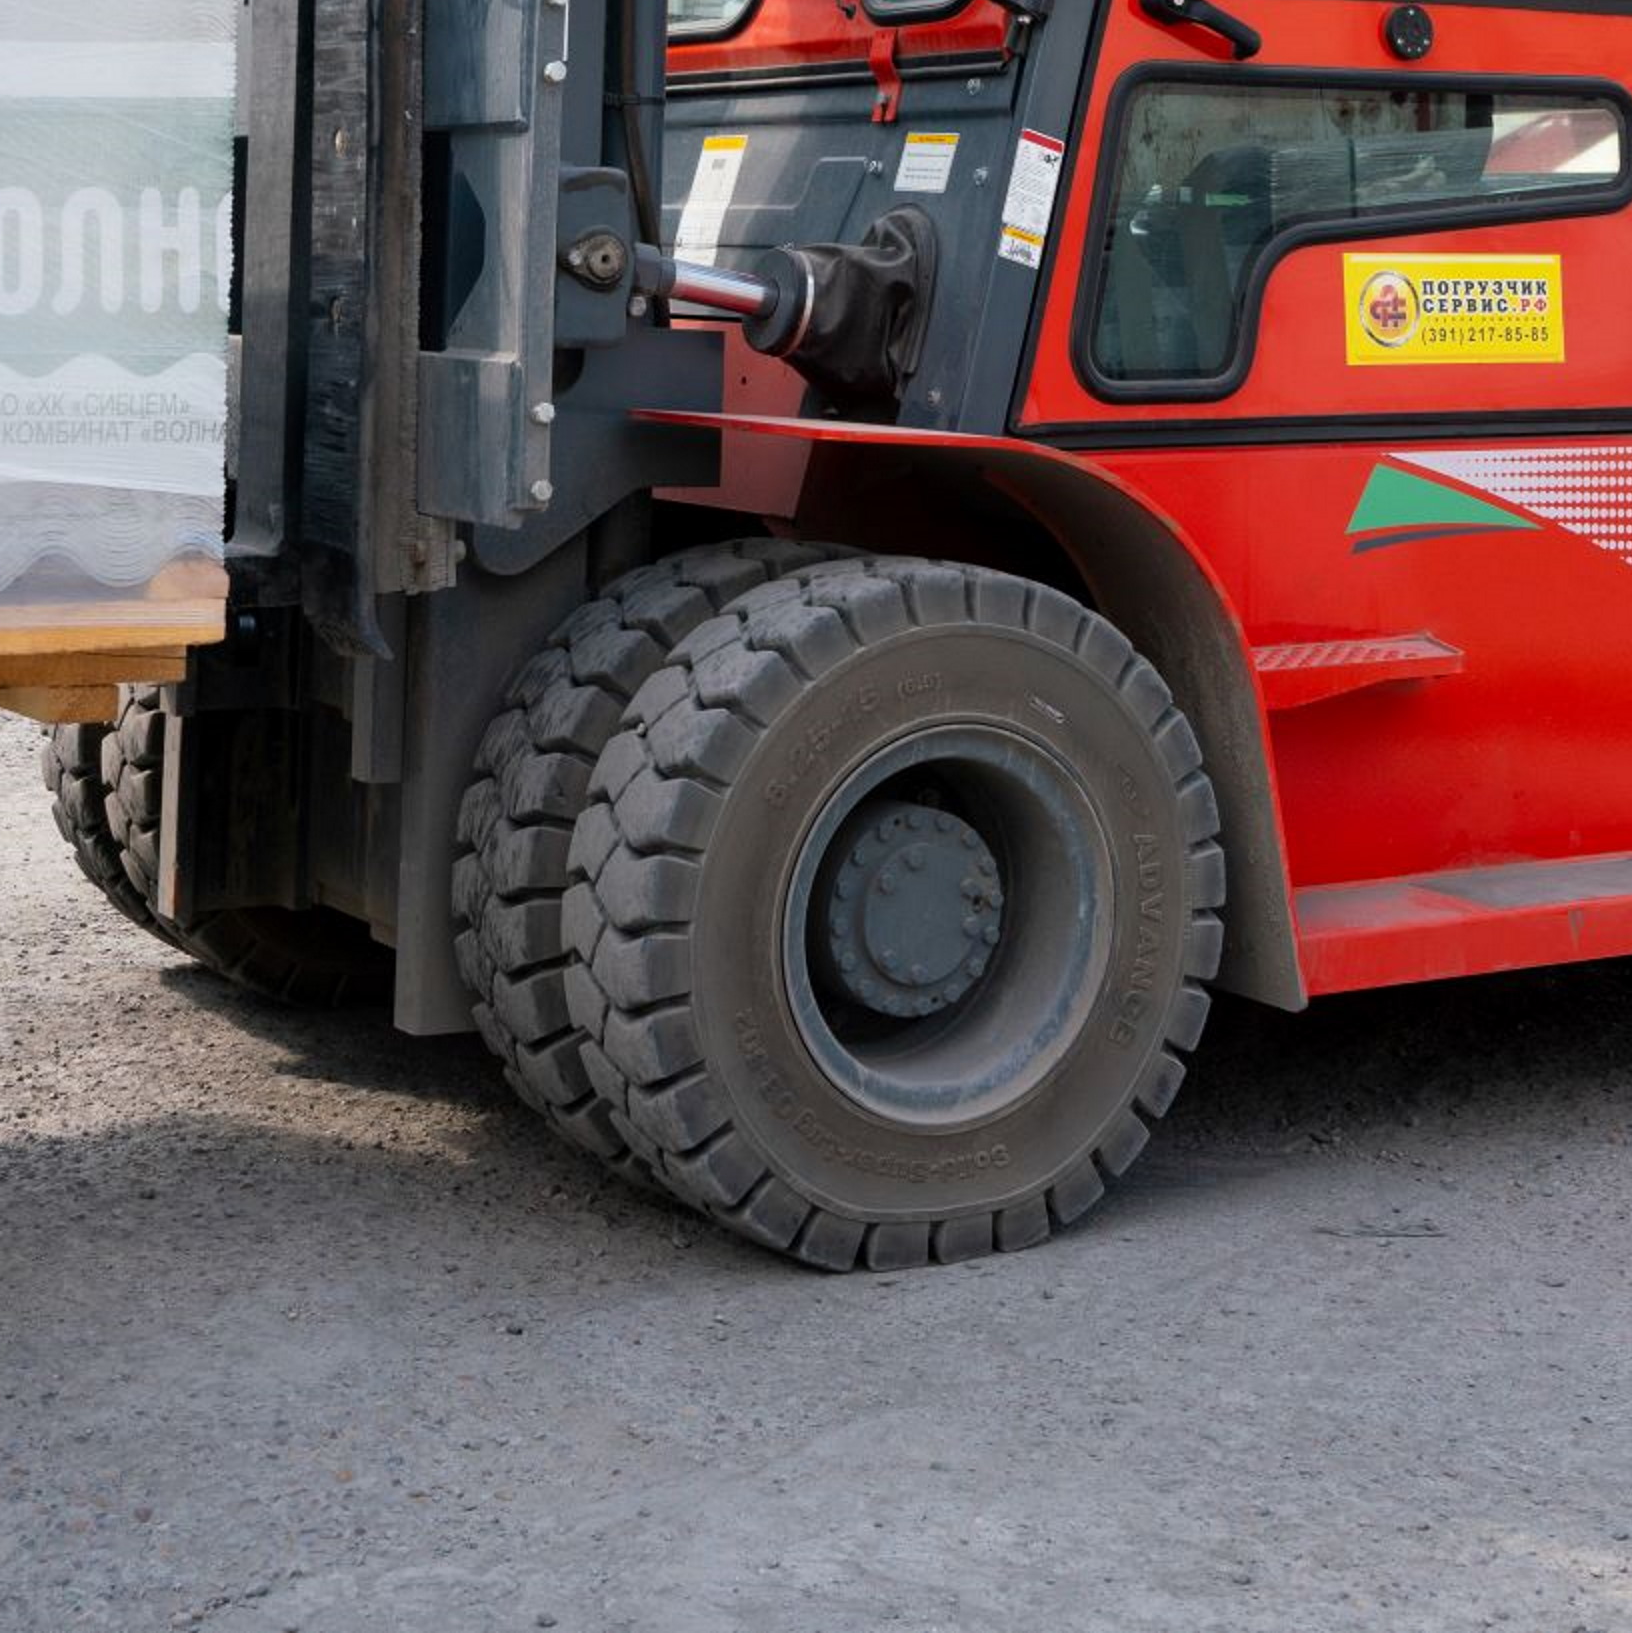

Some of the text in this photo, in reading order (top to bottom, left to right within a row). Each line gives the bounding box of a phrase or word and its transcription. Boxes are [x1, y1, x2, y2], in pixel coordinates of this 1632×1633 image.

[1421, 279, 1548, 296] ПОГРУЗЧИК
[1421, 298, 1548, 314] СЕРВИС.РФ
[26, 392, 64, 417] «ХК
[72, 392, 190, 420] «СИБЦЕМ»
